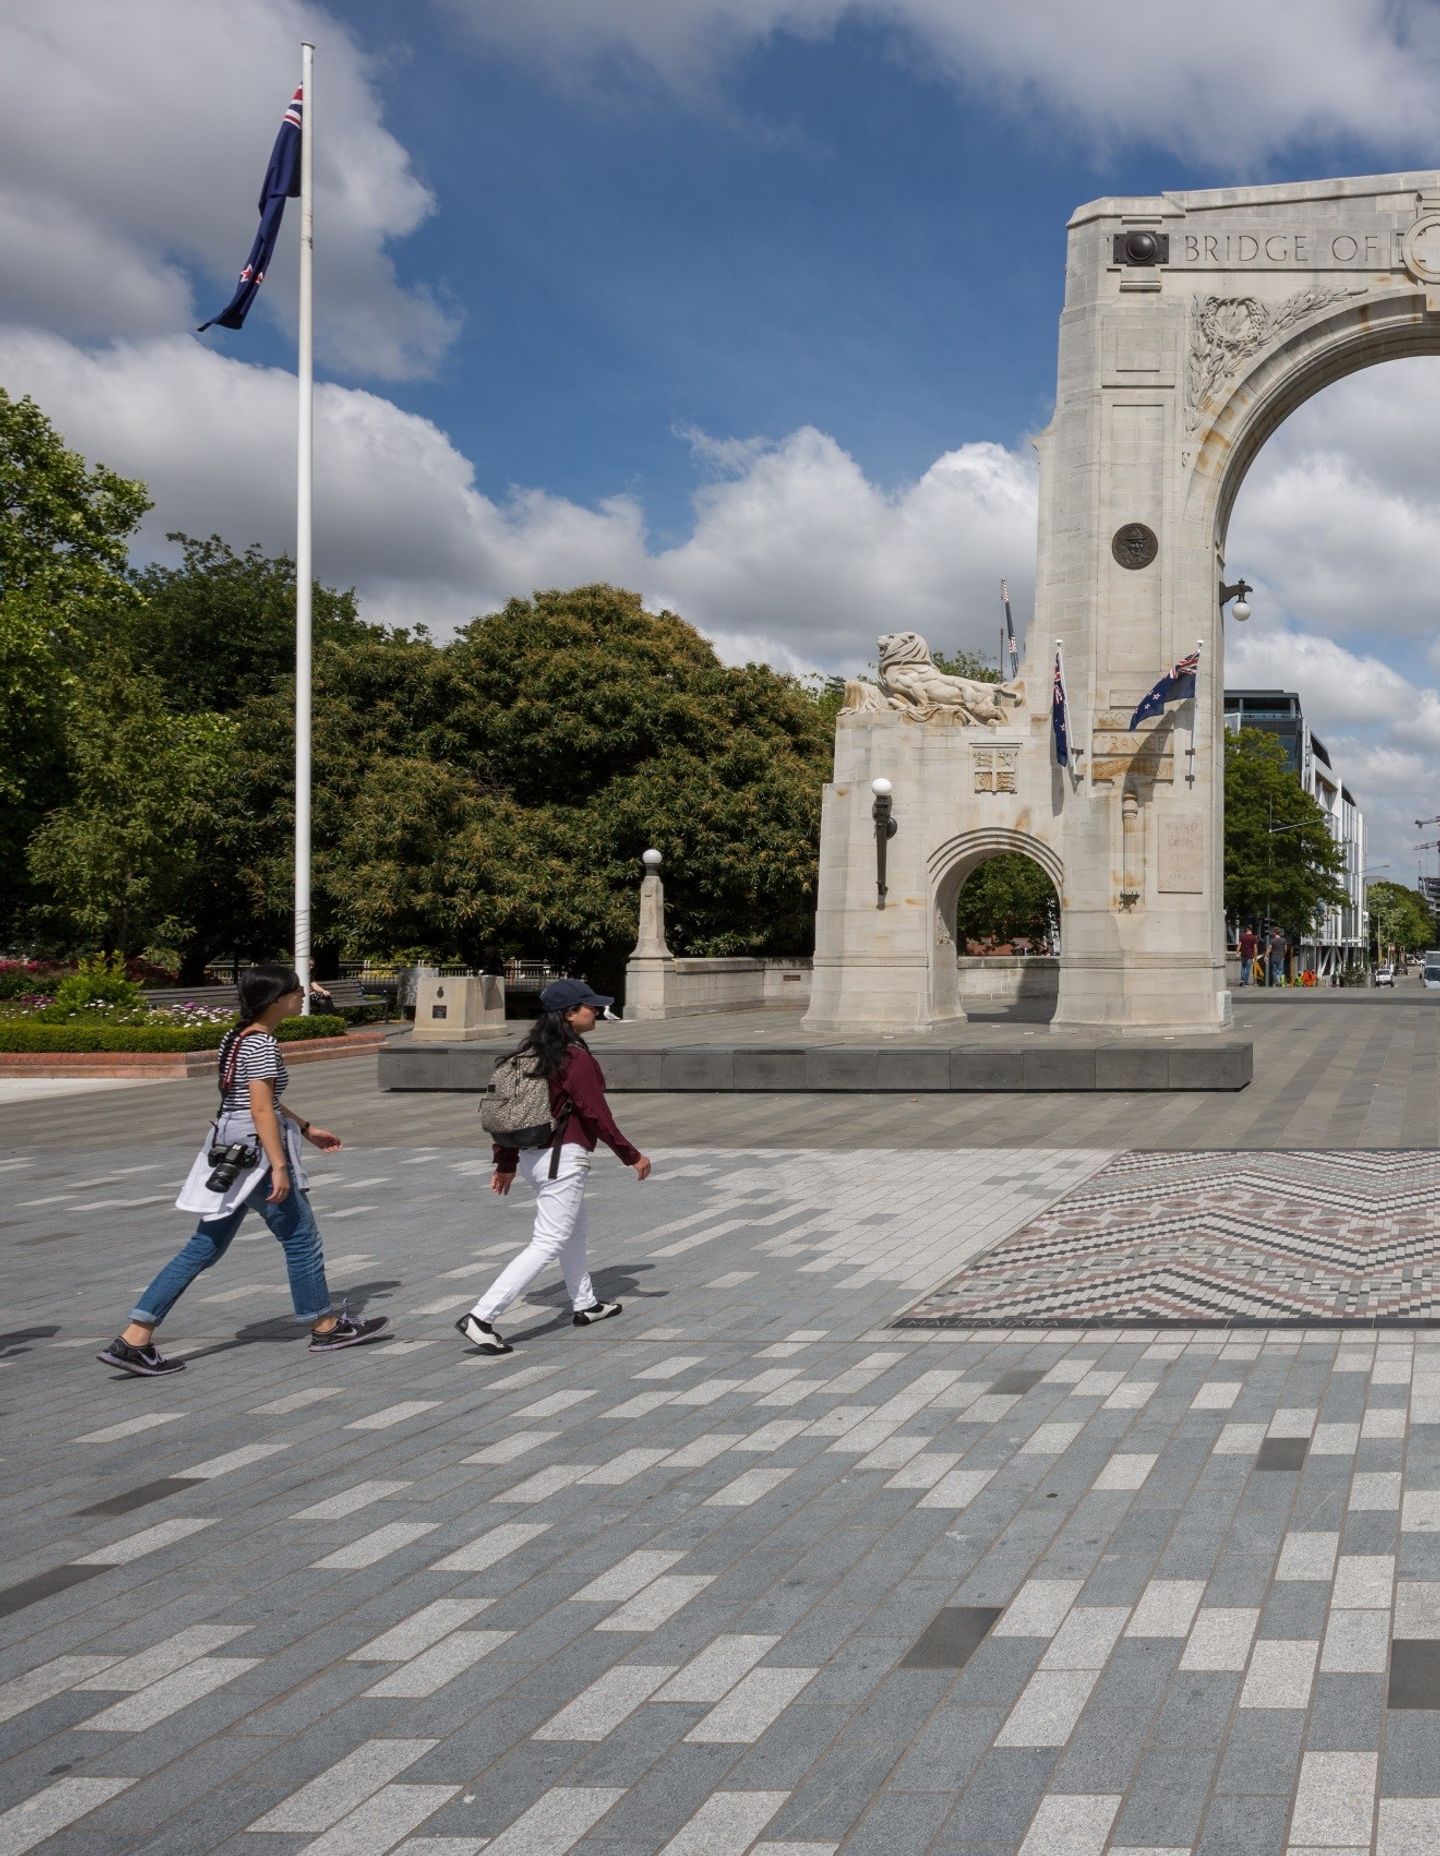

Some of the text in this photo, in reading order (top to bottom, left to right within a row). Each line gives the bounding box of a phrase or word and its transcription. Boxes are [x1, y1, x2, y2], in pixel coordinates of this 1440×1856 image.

[1184, 235, 1309, 262] BRIDGE
[1331, 235, 1379, 262] OF
[1101, 735, 1166, 752] FRANCE
